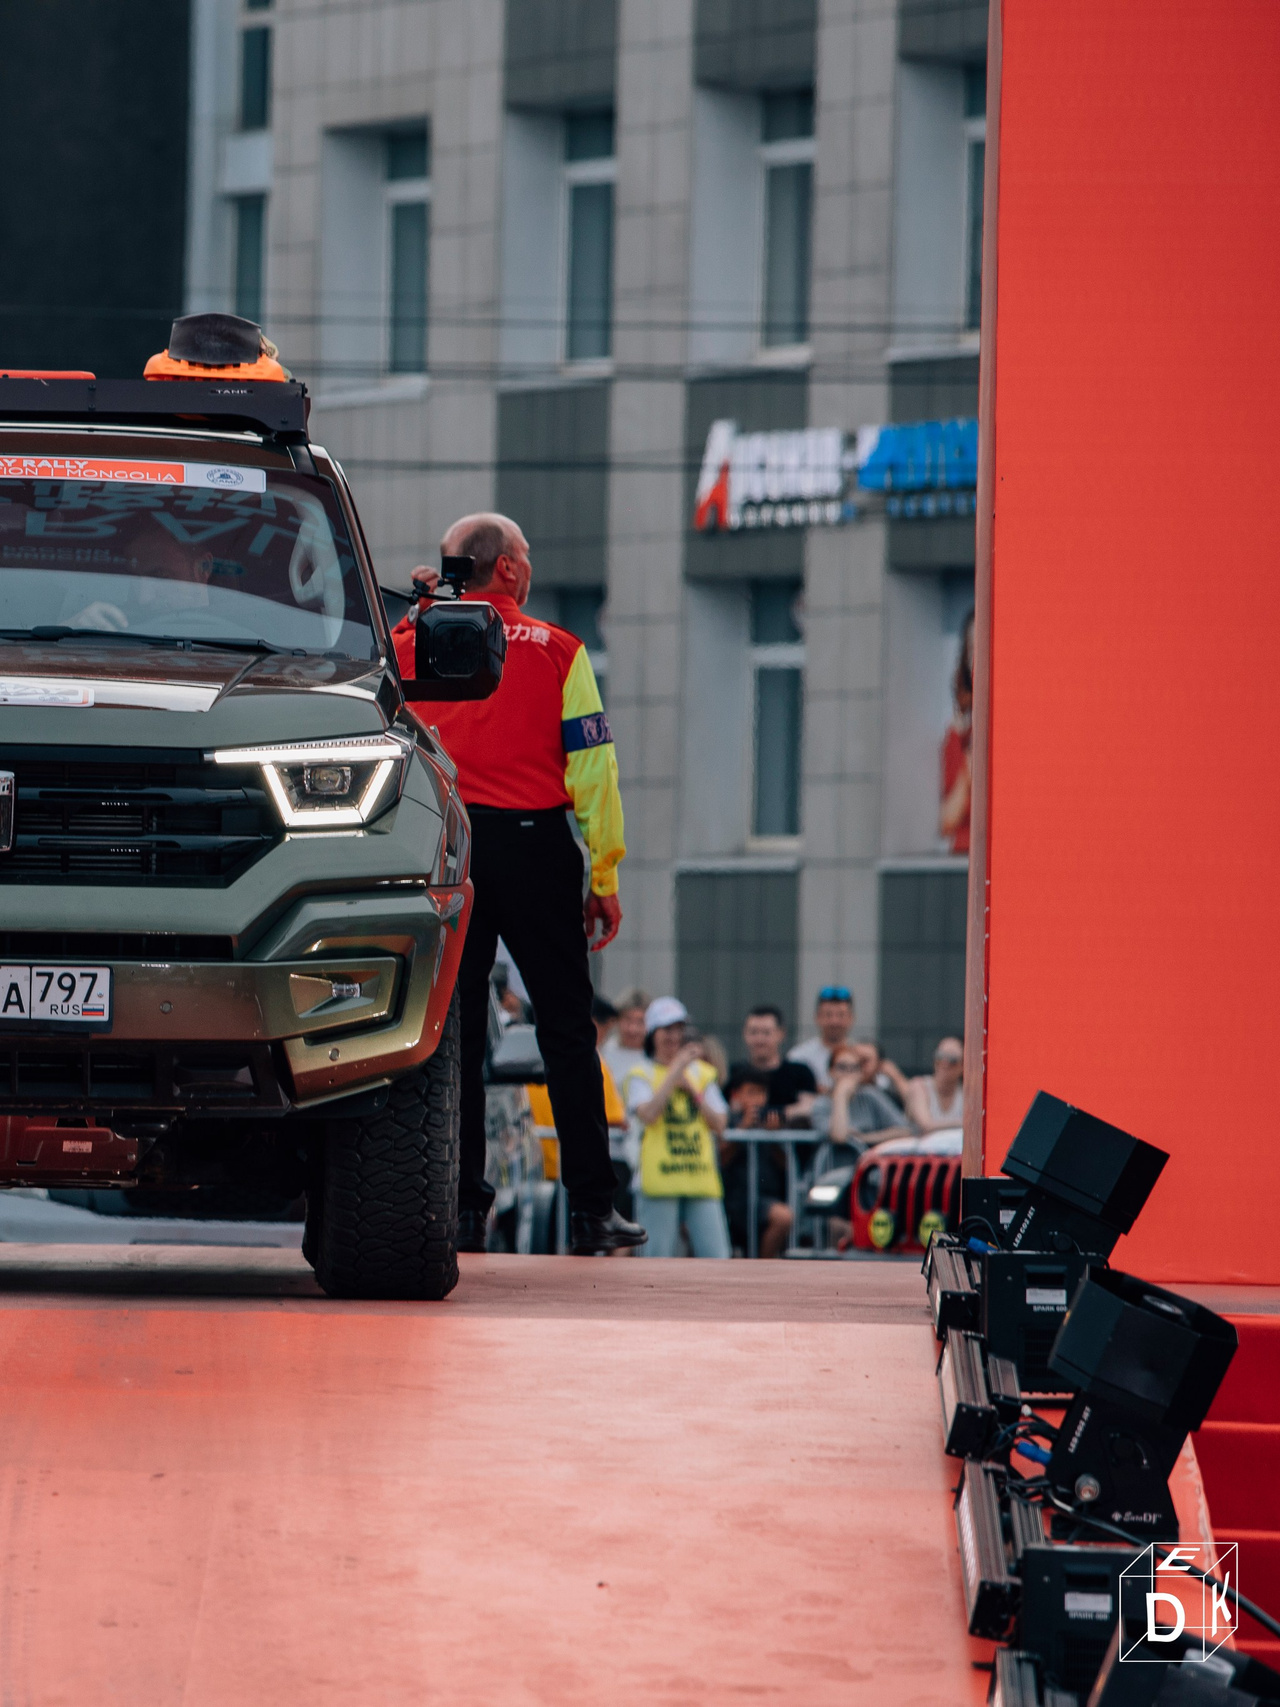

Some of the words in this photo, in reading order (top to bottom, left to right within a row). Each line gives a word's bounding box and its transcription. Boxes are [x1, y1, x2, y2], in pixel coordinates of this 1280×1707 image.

[22, 458, 89, 470] RALLY
[66, 468, 177, 483] MONGOLIA
[35, 971, 98, 1003] 797
[50, 1003, 80, 1016] RUS
[1013, 1233, 1023, 1248] LED
